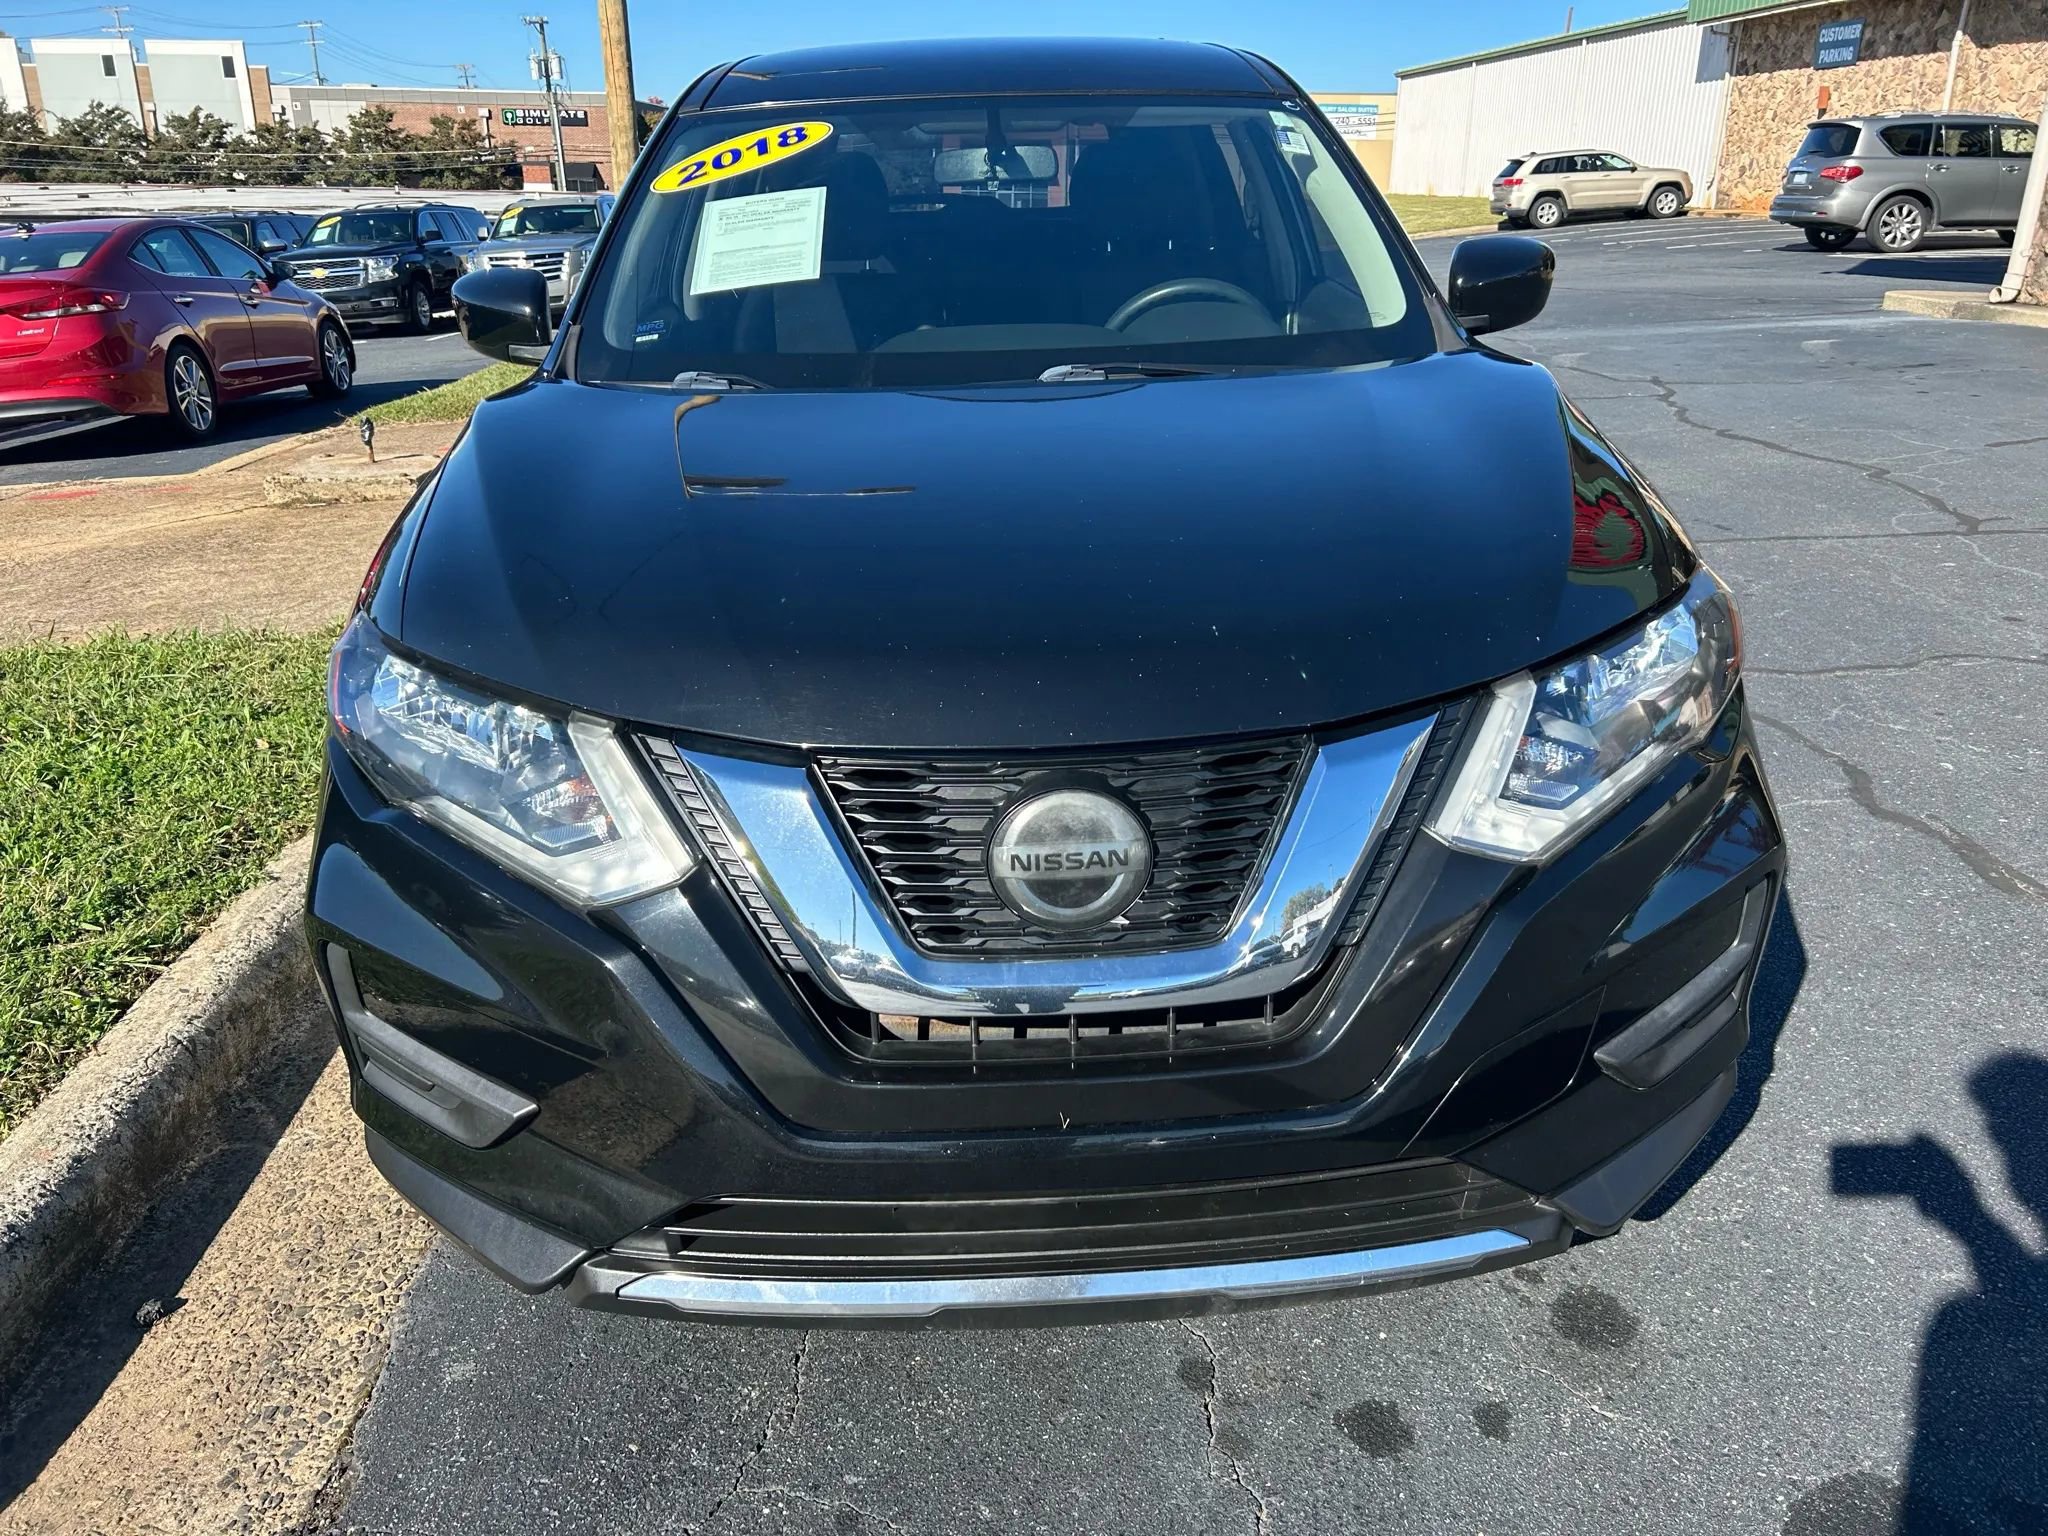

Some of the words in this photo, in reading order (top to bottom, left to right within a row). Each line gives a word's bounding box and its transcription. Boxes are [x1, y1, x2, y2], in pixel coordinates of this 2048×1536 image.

[1820, 23, 1862, 43] CUSTOMER
[1818, 46, 1854, 64] PARKING
[515, 109, 585, 118] SIMUATE
[677, 126, 808, 187] 2018
[1010, 848, 1129, 872] NISSAN
